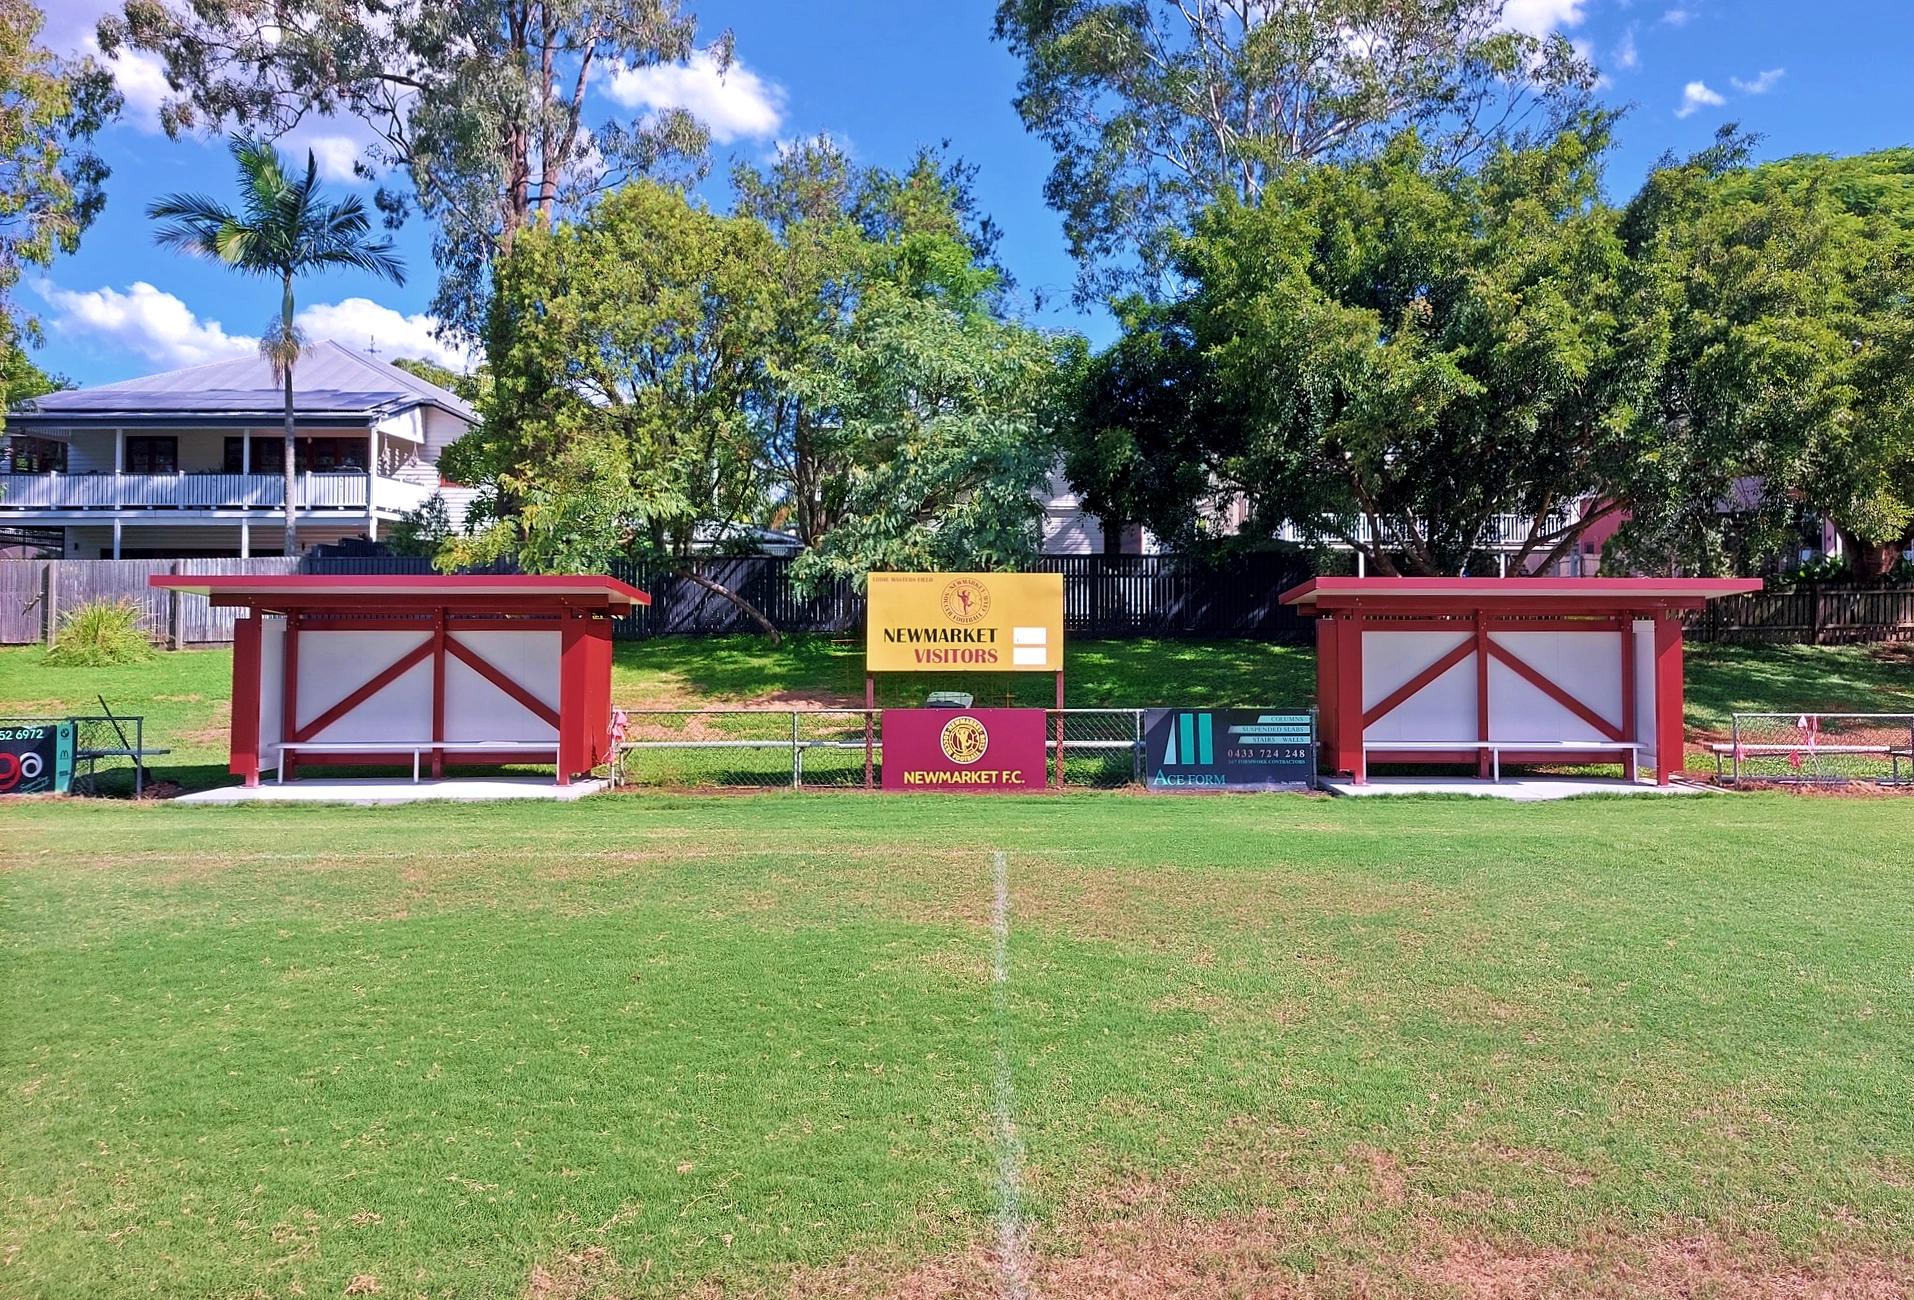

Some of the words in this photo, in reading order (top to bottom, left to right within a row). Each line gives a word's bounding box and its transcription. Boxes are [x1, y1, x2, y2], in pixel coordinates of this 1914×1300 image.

[949, 579, 986, 593] NEWMARKET
[884, 627, 998, 643] NEWMARKET
[914, 648, 998, 664] VISITORS
[948, 717, 983, 732] NEWMARKET
[15, 729, 44, 740] 6972
[943, 731, 953, 756] SOCCER
[952, 751, 981, 763] FOOTBALL
[1227, 749, 1254, 758] 0433
[1260, 749, 1279, 758] 724
[1285, 749, 1306, 758] 248
[904, 771, 999, 784] NEWMARKET
[1002, 771, 1025, 784] F.C.
[1188, 774, 1226, 785] FORM
